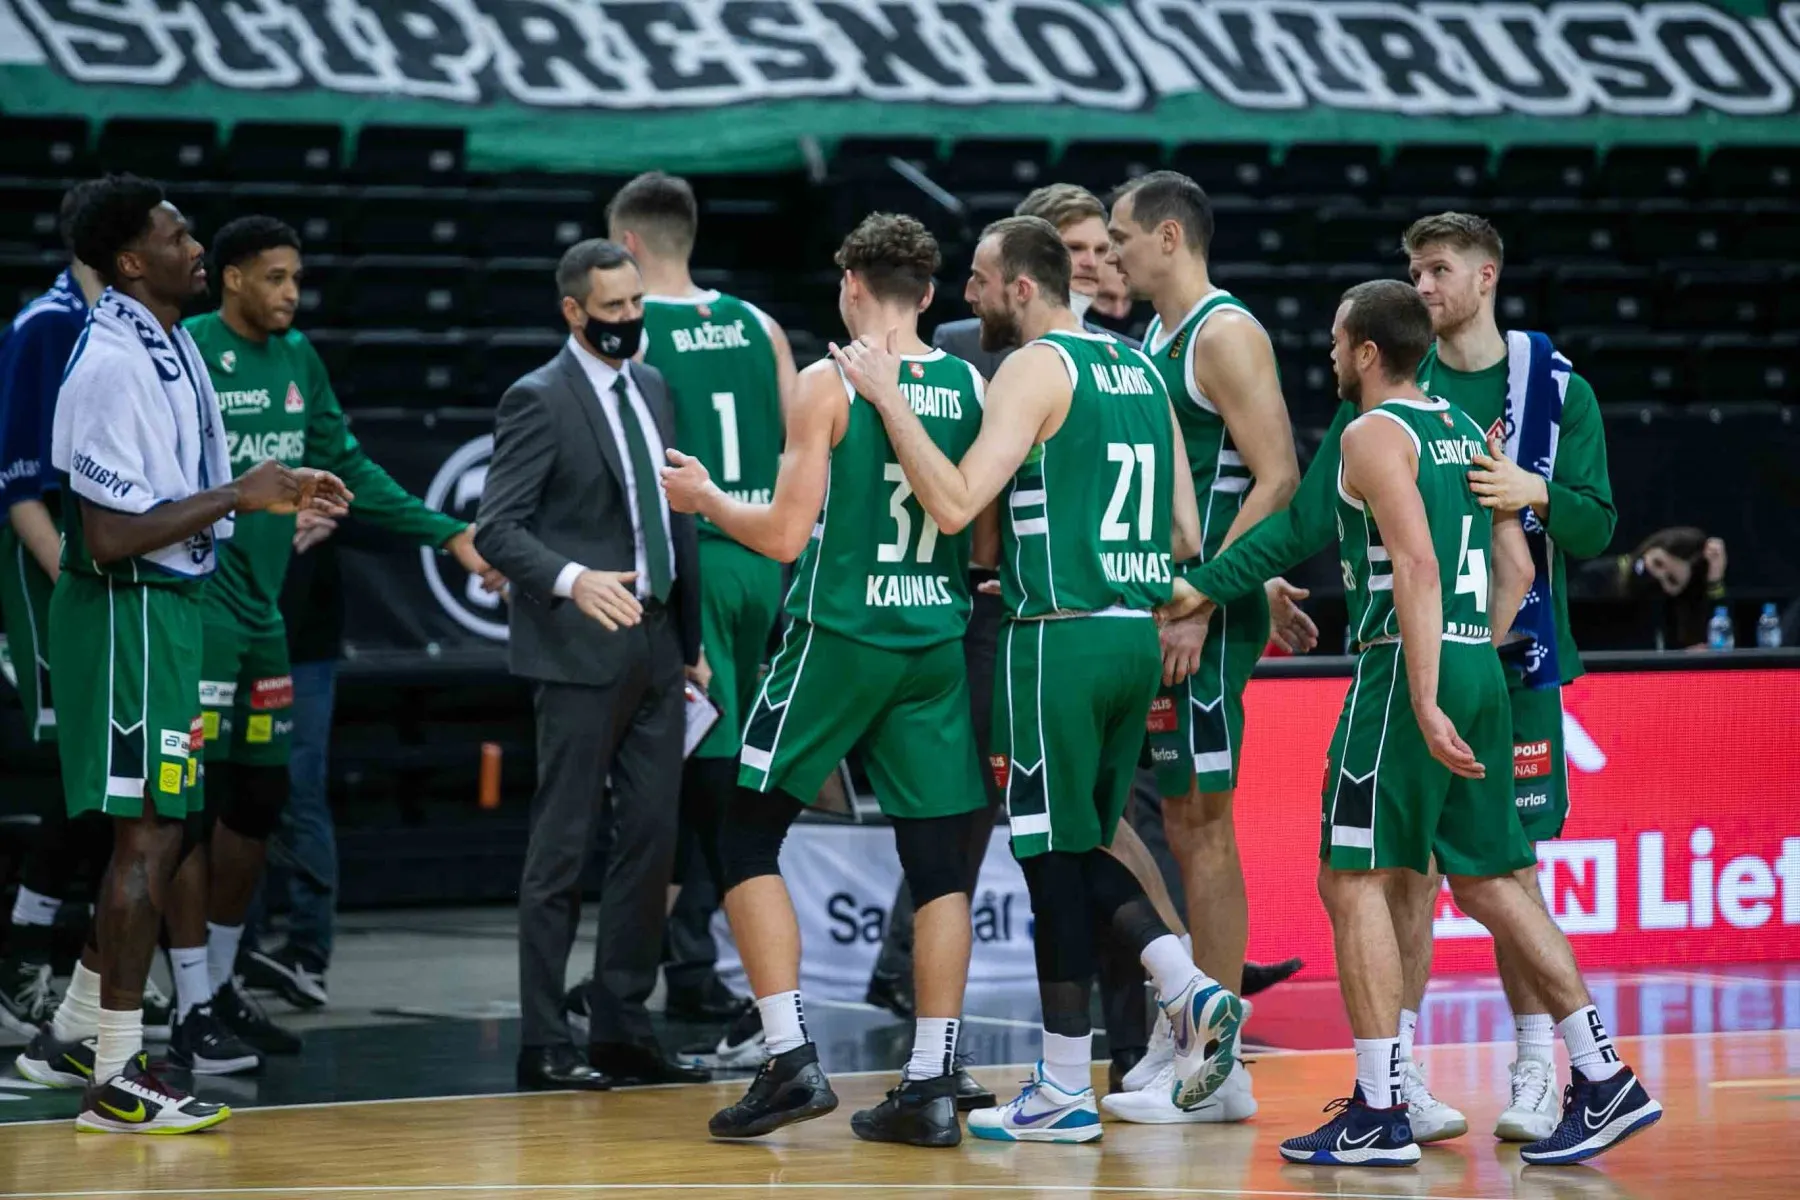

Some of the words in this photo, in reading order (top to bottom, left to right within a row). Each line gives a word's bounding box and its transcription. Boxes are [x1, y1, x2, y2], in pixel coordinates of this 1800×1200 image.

[18, 0, 1148, 106] STIPRESNIO
[1136, 0, 1793, 114] VIRUSO
[898, 382, 963, 420] UBAITIS
[711, 392, 741, 482] 1
[1100, 442, 1156, 541] 21
[1454, 515, 1488, 613] 4
[866, 574, 953, 607] KAUNAS
[1514, 742, 1547, 757] POLIS
[1514, 763, 1538, 776] NAS
[1515, 793, 1547, 807] erlas
